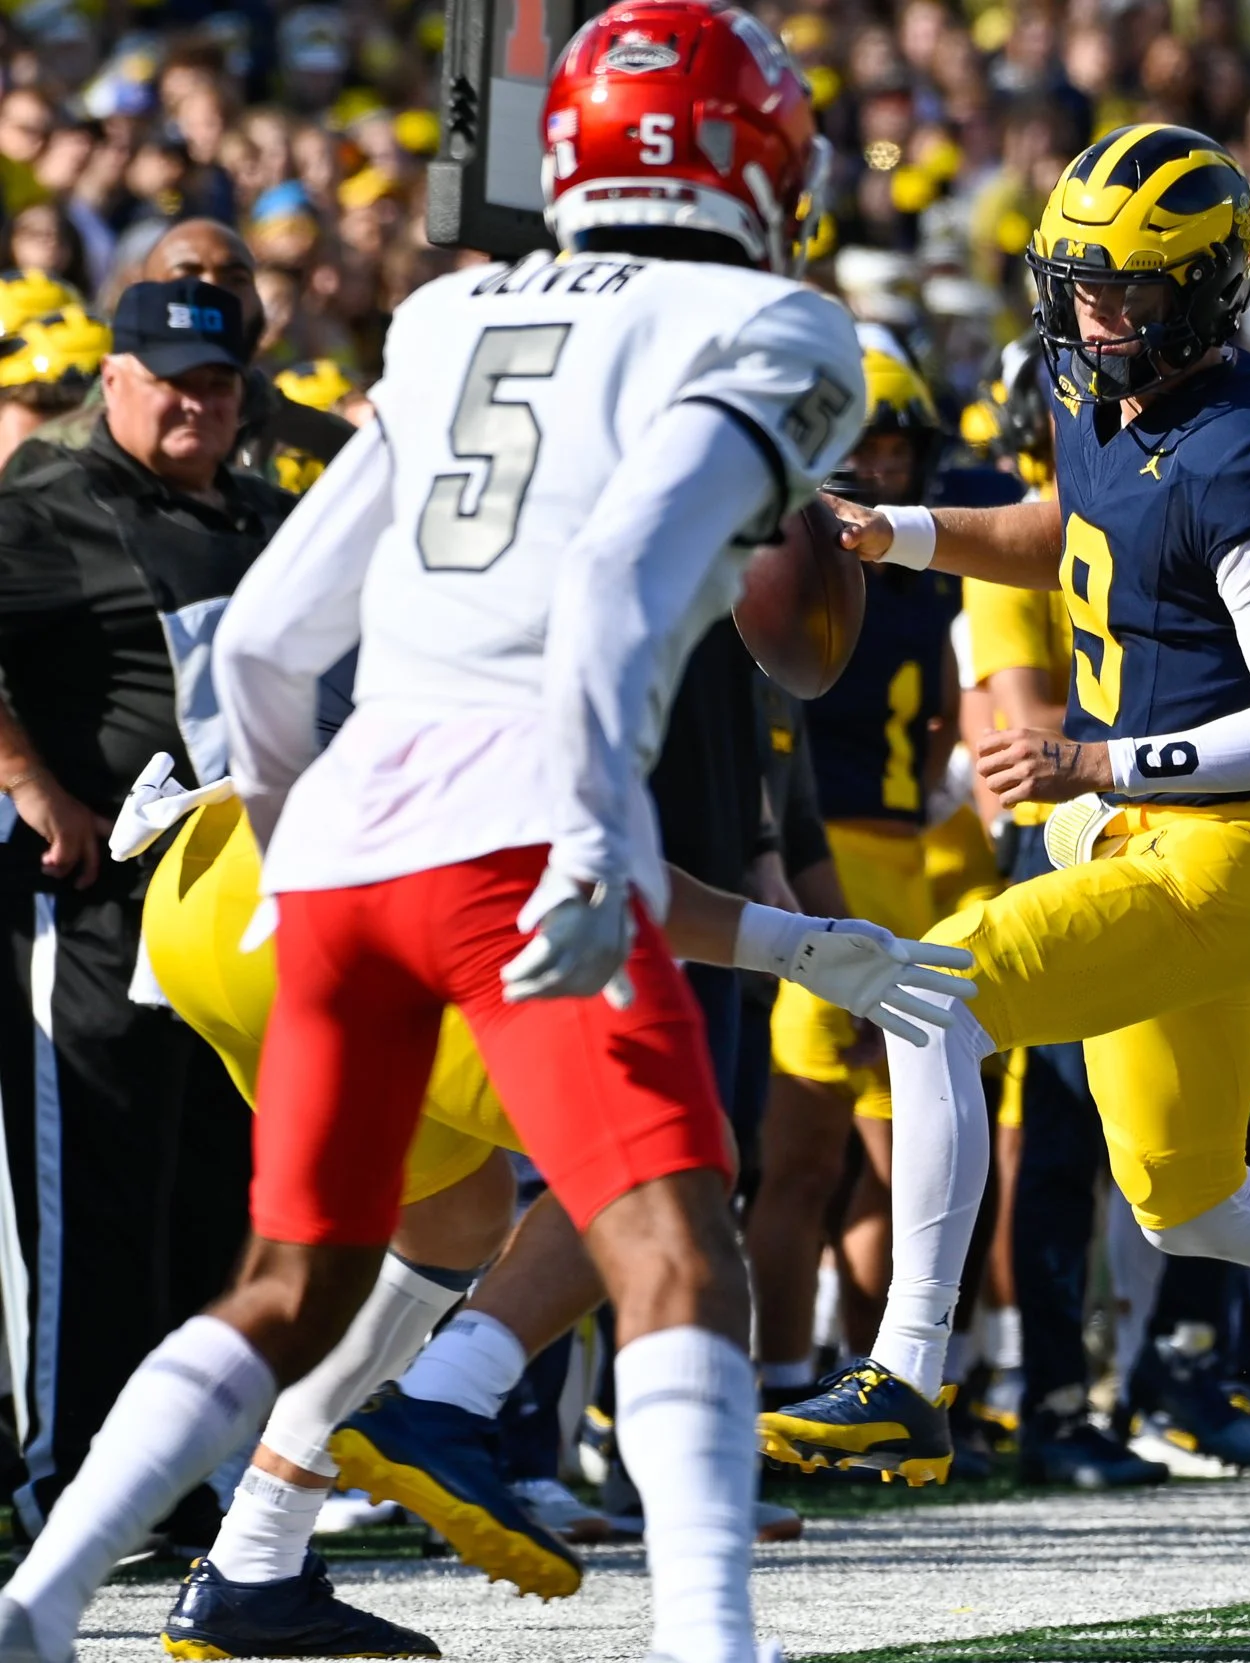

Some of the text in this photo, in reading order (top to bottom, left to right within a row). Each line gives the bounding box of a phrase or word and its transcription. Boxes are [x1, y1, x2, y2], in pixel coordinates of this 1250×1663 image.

[639, 113, 674, 165] 5
[1066, 241, 1086, 258] M
[777, 364, 853, 470] 5
[415, 322, 574, 573] 5
[1058, 511, 1124, 727] 9
[1042, 740, 1082, 773] 47
[1136, 740, 1200, 779] 9
